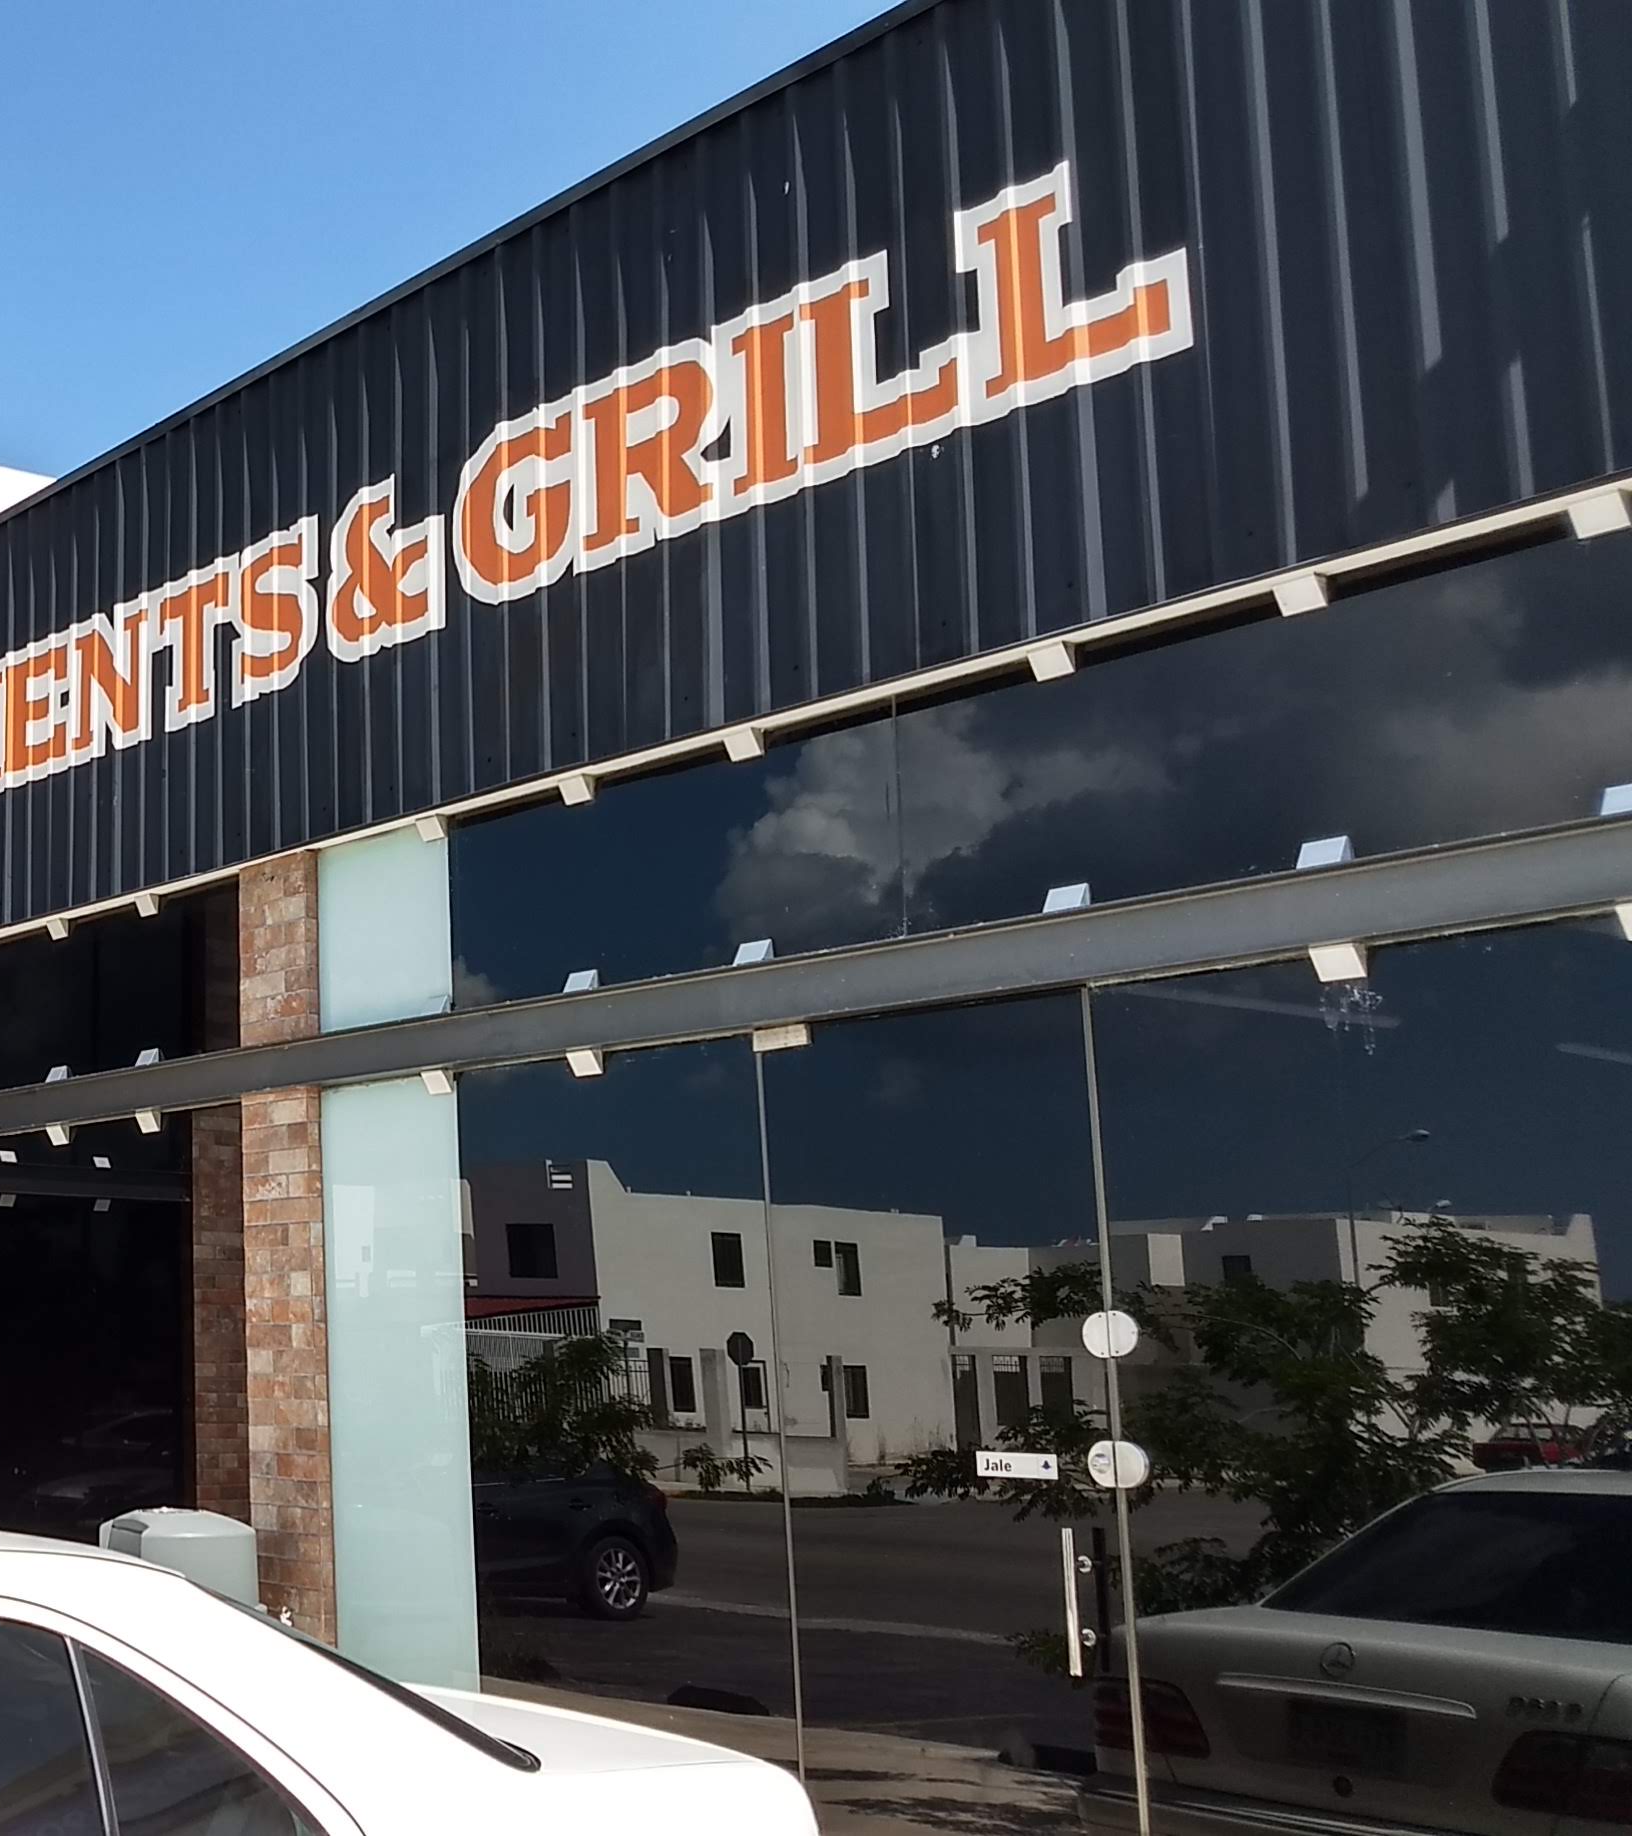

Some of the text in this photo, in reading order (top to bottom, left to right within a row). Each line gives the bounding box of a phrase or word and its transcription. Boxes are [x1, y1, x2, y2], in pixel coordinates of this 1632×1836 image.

[327, 475, 445, 662] &
[453, 160, 1193, 604] GRILL
[984, 1458, 1013, 1472] Jale
